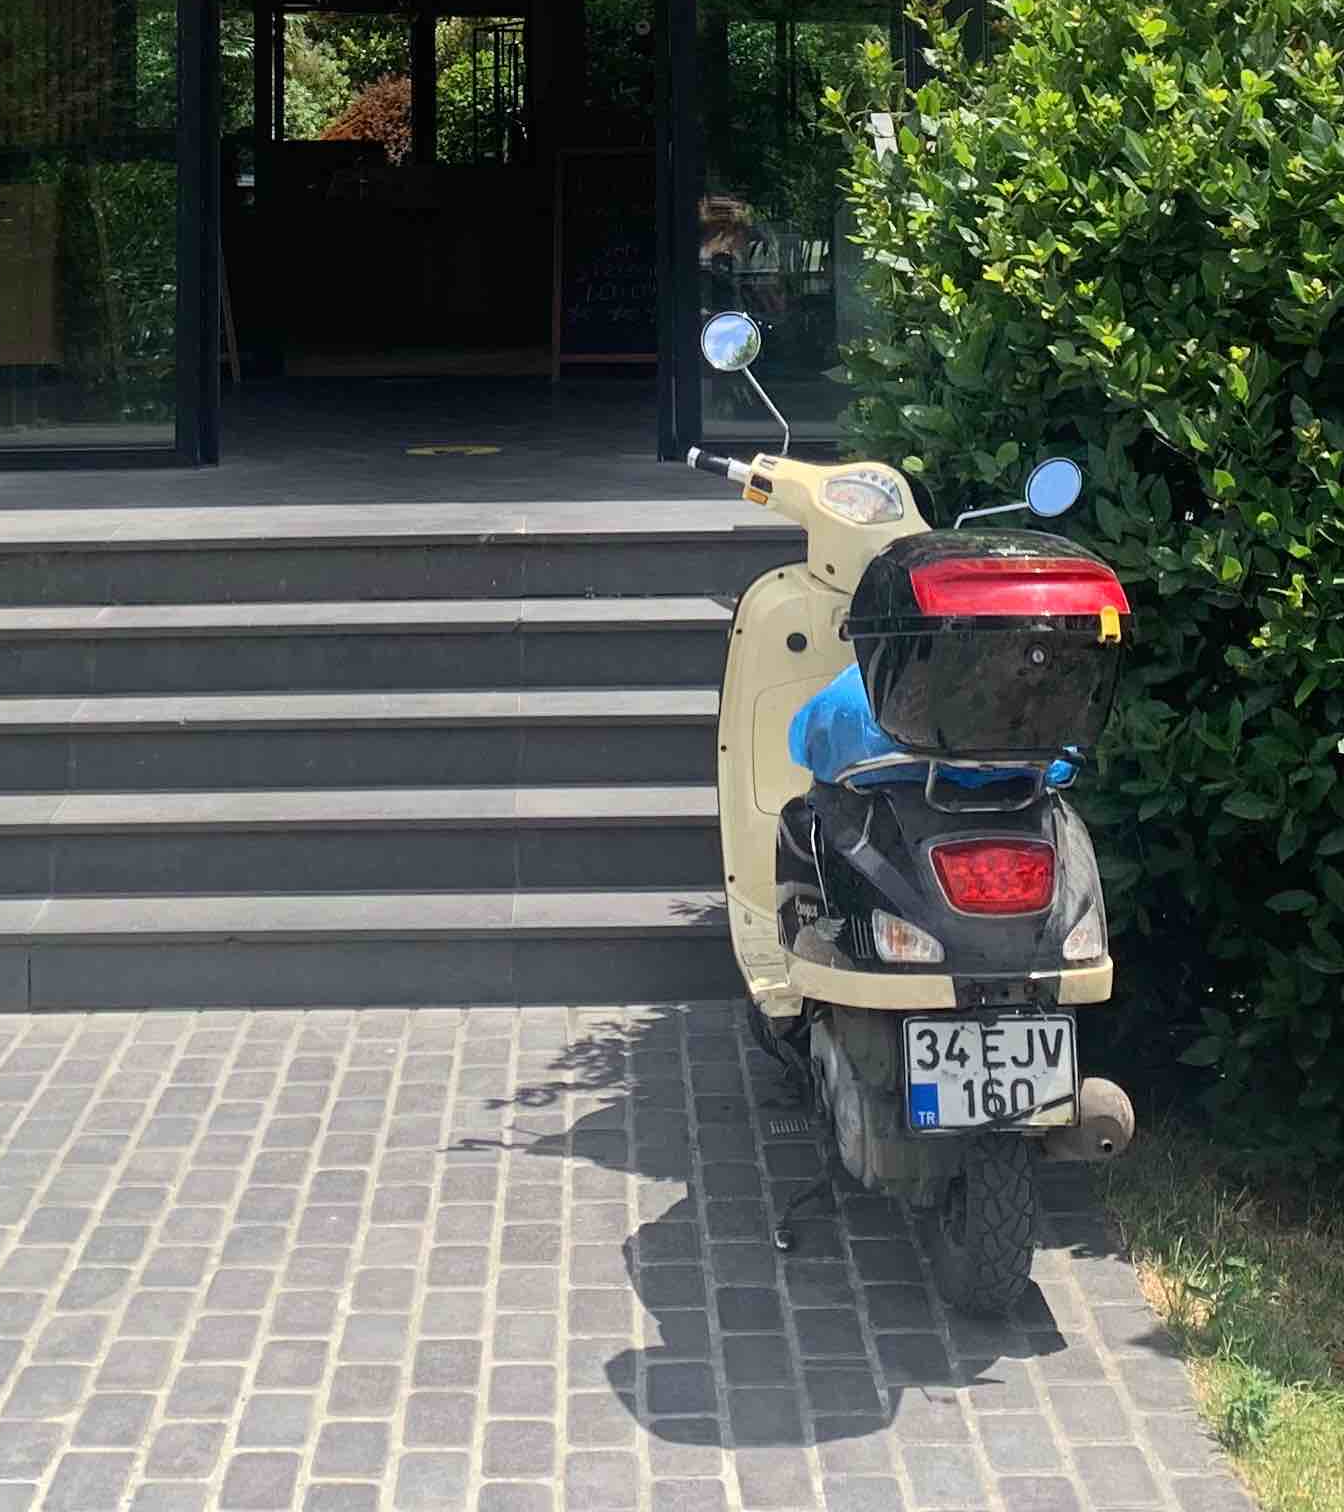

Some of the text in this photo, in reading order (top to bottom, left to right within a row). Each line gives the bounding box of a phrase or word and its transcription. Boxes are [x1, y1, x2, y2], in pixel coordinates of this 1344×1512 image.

[916, 1028, 1065, 1070] 34 EJV
[917, 1110, 937, 1126] TR
[962, 1077, 1035, 1120] 160
